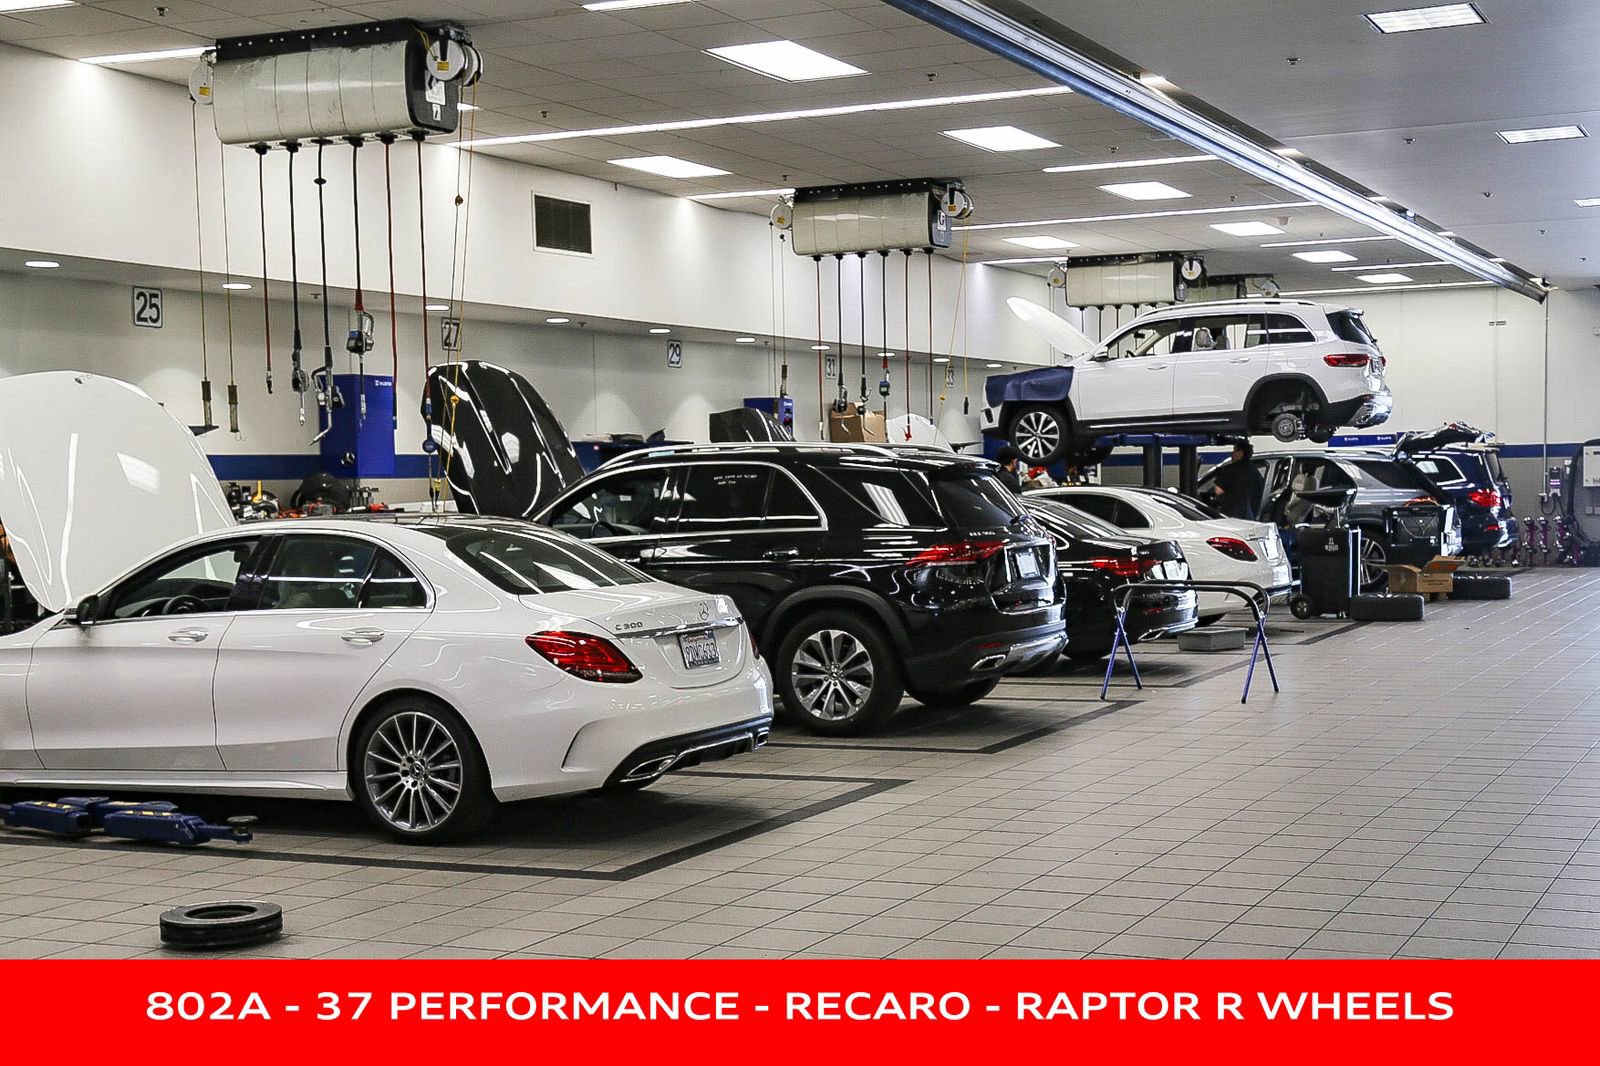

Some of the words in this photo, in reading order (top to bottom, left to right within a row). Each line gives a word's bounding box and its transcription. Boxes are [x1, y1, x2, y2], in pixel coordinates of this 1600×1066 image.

[136, 291, 161, 324] 25
[443, 321, 460, 348] 27
[669, 342, 681, 365] 29
[623, 621, 644, 630] 300
